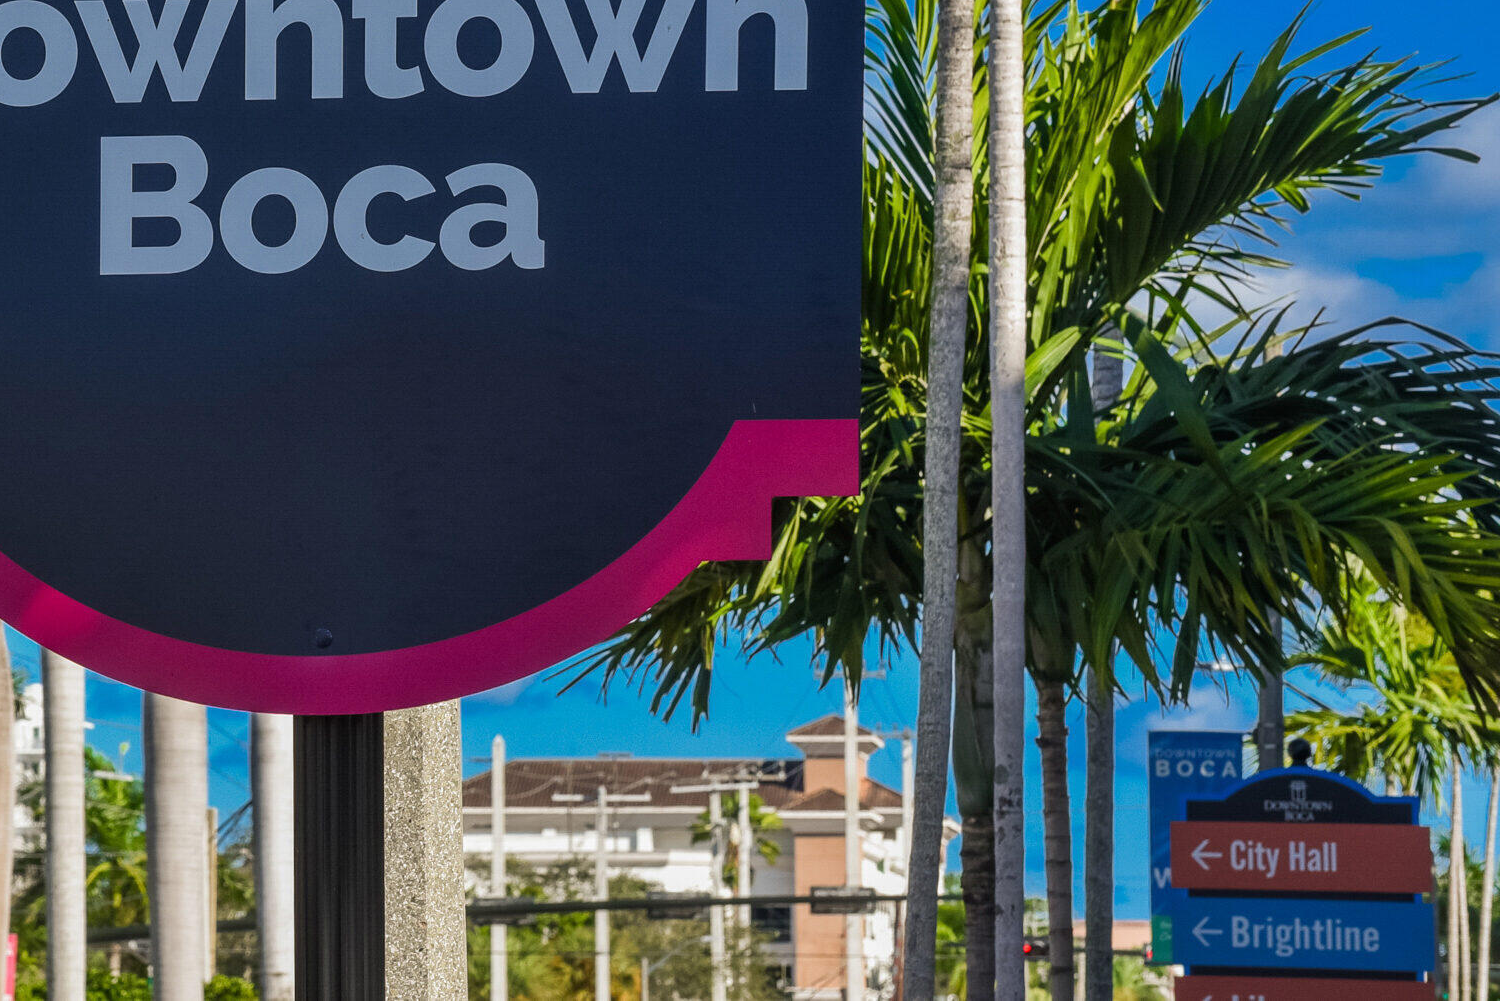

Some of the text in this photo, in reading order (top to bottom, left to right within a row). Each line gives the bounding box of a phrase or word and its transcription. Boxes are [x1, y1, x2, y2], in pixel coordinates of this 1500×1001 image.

[99, 134, 546, 277] Boca
[1154, 747, 1237, 760] DOWNTOWN
[1155, 759, 1238, 778] BOCA
[1229, 839, 1338, 878] City Hall
[1231, 915, 1380, 958] Brightline
